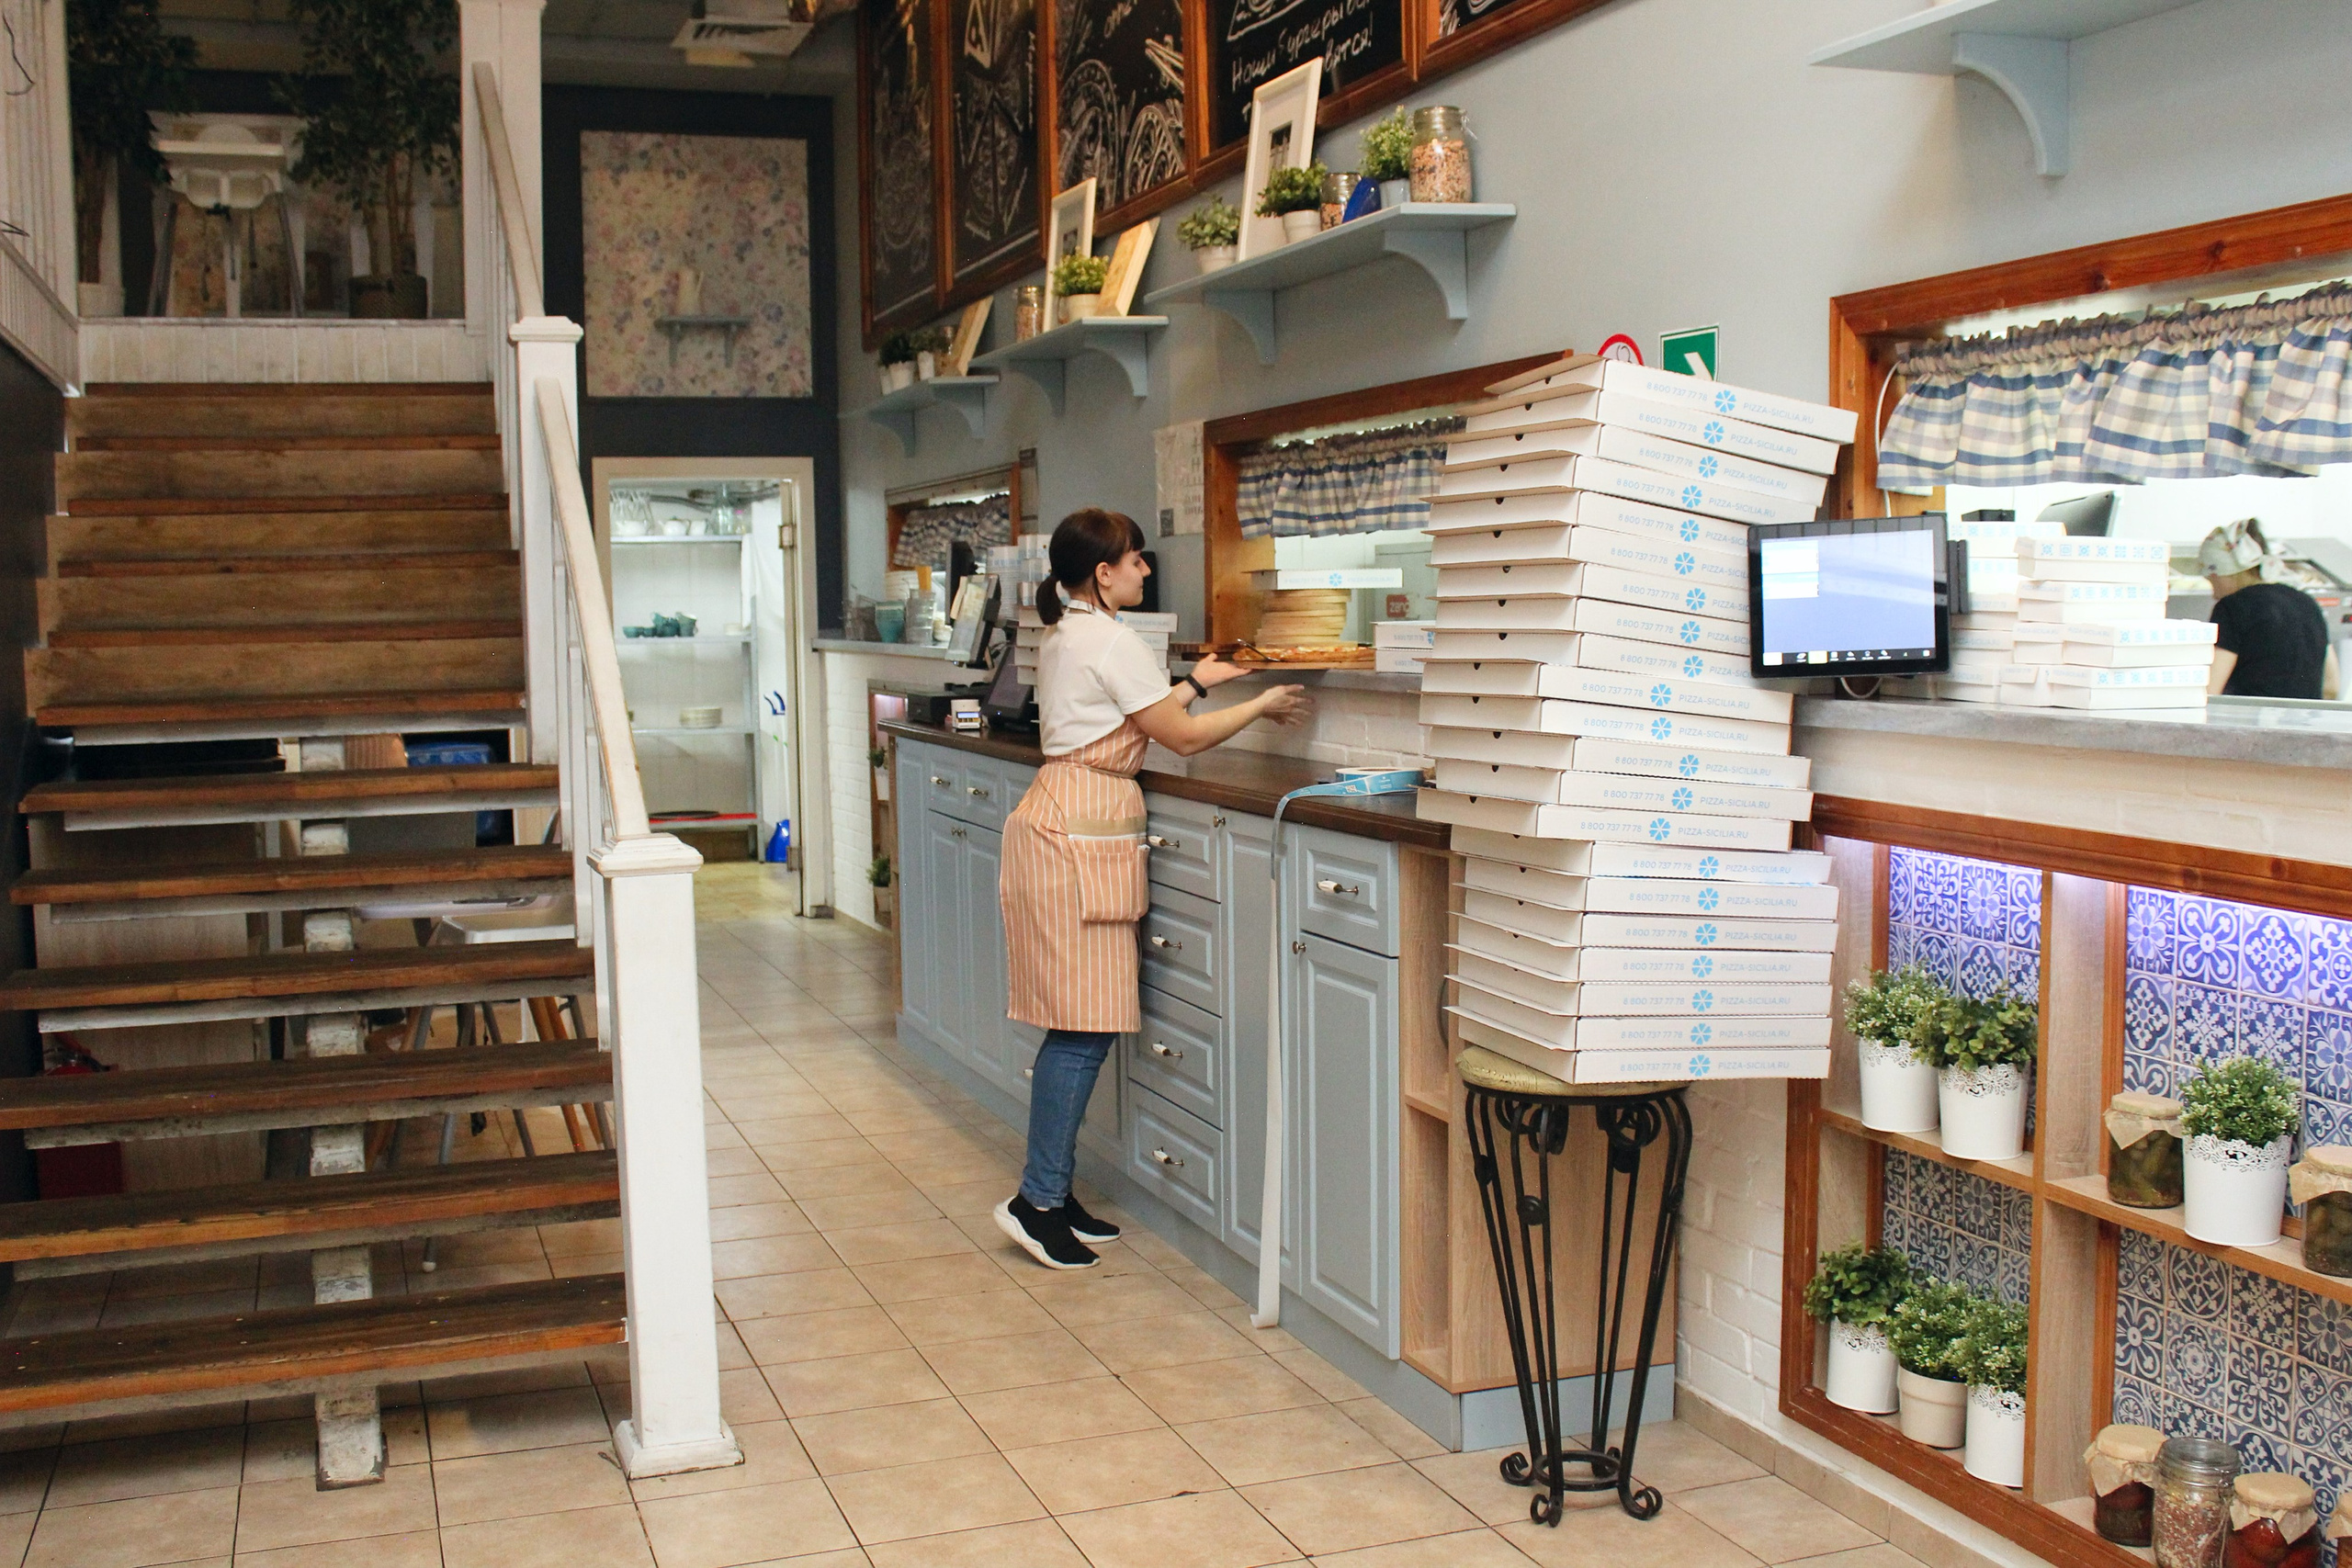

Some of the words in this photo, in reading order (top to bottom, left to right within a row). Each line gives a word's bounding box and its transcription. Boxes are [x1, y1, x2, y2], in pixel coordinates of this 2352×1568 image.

[1653, 383, 1670, 393] 800
[1672, 387, 1686, 396] 737
[1698, 392, 1708, 401] 78
[1744, 402, 1814, 423] PIZZA-SICILIA.RU
[1645, 414, 1662, 424] 800
[1663, 418, 1677, 427] 737
[1688, 423, 1698, 433] 78
[1731, 434, 1797, 455] PIZZA-SICILIA.RU
[1645, 449, 1660, 459] 800
[1662, 453, 1675, 462] 737
[1684, 458, 1693, 467] 78
[1724, 468, 1787, 490] PIZZA-SICILIA.RU
[1623, 479, 1640, 490] 800
[1641, 483, 1655, 492] 737
[1656, 486, 1666, 494] 77
[1666, 489, 1676, 497] 78
[1709, 498, 1775, 517] PIZZA-SICILIA.RU
[1624, 515, 1640, 525] 800
[1642, 518, 1655, 527] 737
[1665, 523, 1674, 531] 78
[1616, 548, 1634, 558] 800
[1634, 551, 1648, 560] 737
[1649, 553, 1658, 562] 77
[1658, 556, 1668, 564] 78
[1629, 585, 1645, 594] 800
[1646, 588, 1660, 597] 737
[1661, 590, 1670, 598] 77
[1670, 592, 1680, 601] 78
[1623, 619, 1639, 628] 800
[1640, 622, 1654, 630] 737
[1665, 626, 1675, 634] 78
[1626, 655, 1643, 664] 800
[1644, 657, 1657, 665] 737
[1668, 660, 1678, 669] 78
[1589, 683, 1606, 693] 800
[1608, 686, 1622, 694] 737
[1634, 689, 1644, 697] 78
[1679, 694, 1750, 709] PIZZA-SICILIA.RU
[1589, 718, 1608, 728] 800
[1609, 720, 1623, 729] 737
[1634, 723, 1645, 731] 78
[1679, 728, 1748, 740] PIZZA-SICILIA.RU
[1639, 758, 1653, 766] 737
[1706, 763, 1770, 776] PIZZA-SICILIA.RU
[1610, 790, 1627, 798] 800
[1629, 791, 1644, 799] 737
[1701, 796, 1770, 808] PIZZA-SICILIA.RU
[1587, 822, 1605, 830] 800
[1606, 823, 1621, 831] 737
[1632, 824, 1642, 832] 78
[1678, 827, 1748, 839] PIZZA-SICILIA.RU
[1639, 860, 1657, 868] 800
[1725, 864, 1792, 874] PIZZA-SICILIA.RU
[1635, 893, 1654, 901] 800
[1655, 893, 1669, 902] 737
[1680, 895, 1691, 903] 78
[1726, 897, 1798, 907] PIZZA-SICILIA.RU
[1652, 929, 1666, 937] 737
[1724, 931, 1796, 942] PIZZA-SICILIA.RU
[1665, 962, 1674, 970] 77
[1720, 964, 1791, 972] PIZZA-SICILIA.RU
[1649, 997, 1663, 1005] 737
[1675, 997, 1685, 1005] 78
[1721, 997, 1791, 1005] PIZZA-SICILIA.RU
[1646, 1031, 1661, 1039] 737
[1719, 1030, 1790, 1038] PIZZA-SICILIA.RU
[1718, 1061, 1790, 1070] PIZZA-SICILIA.RU
